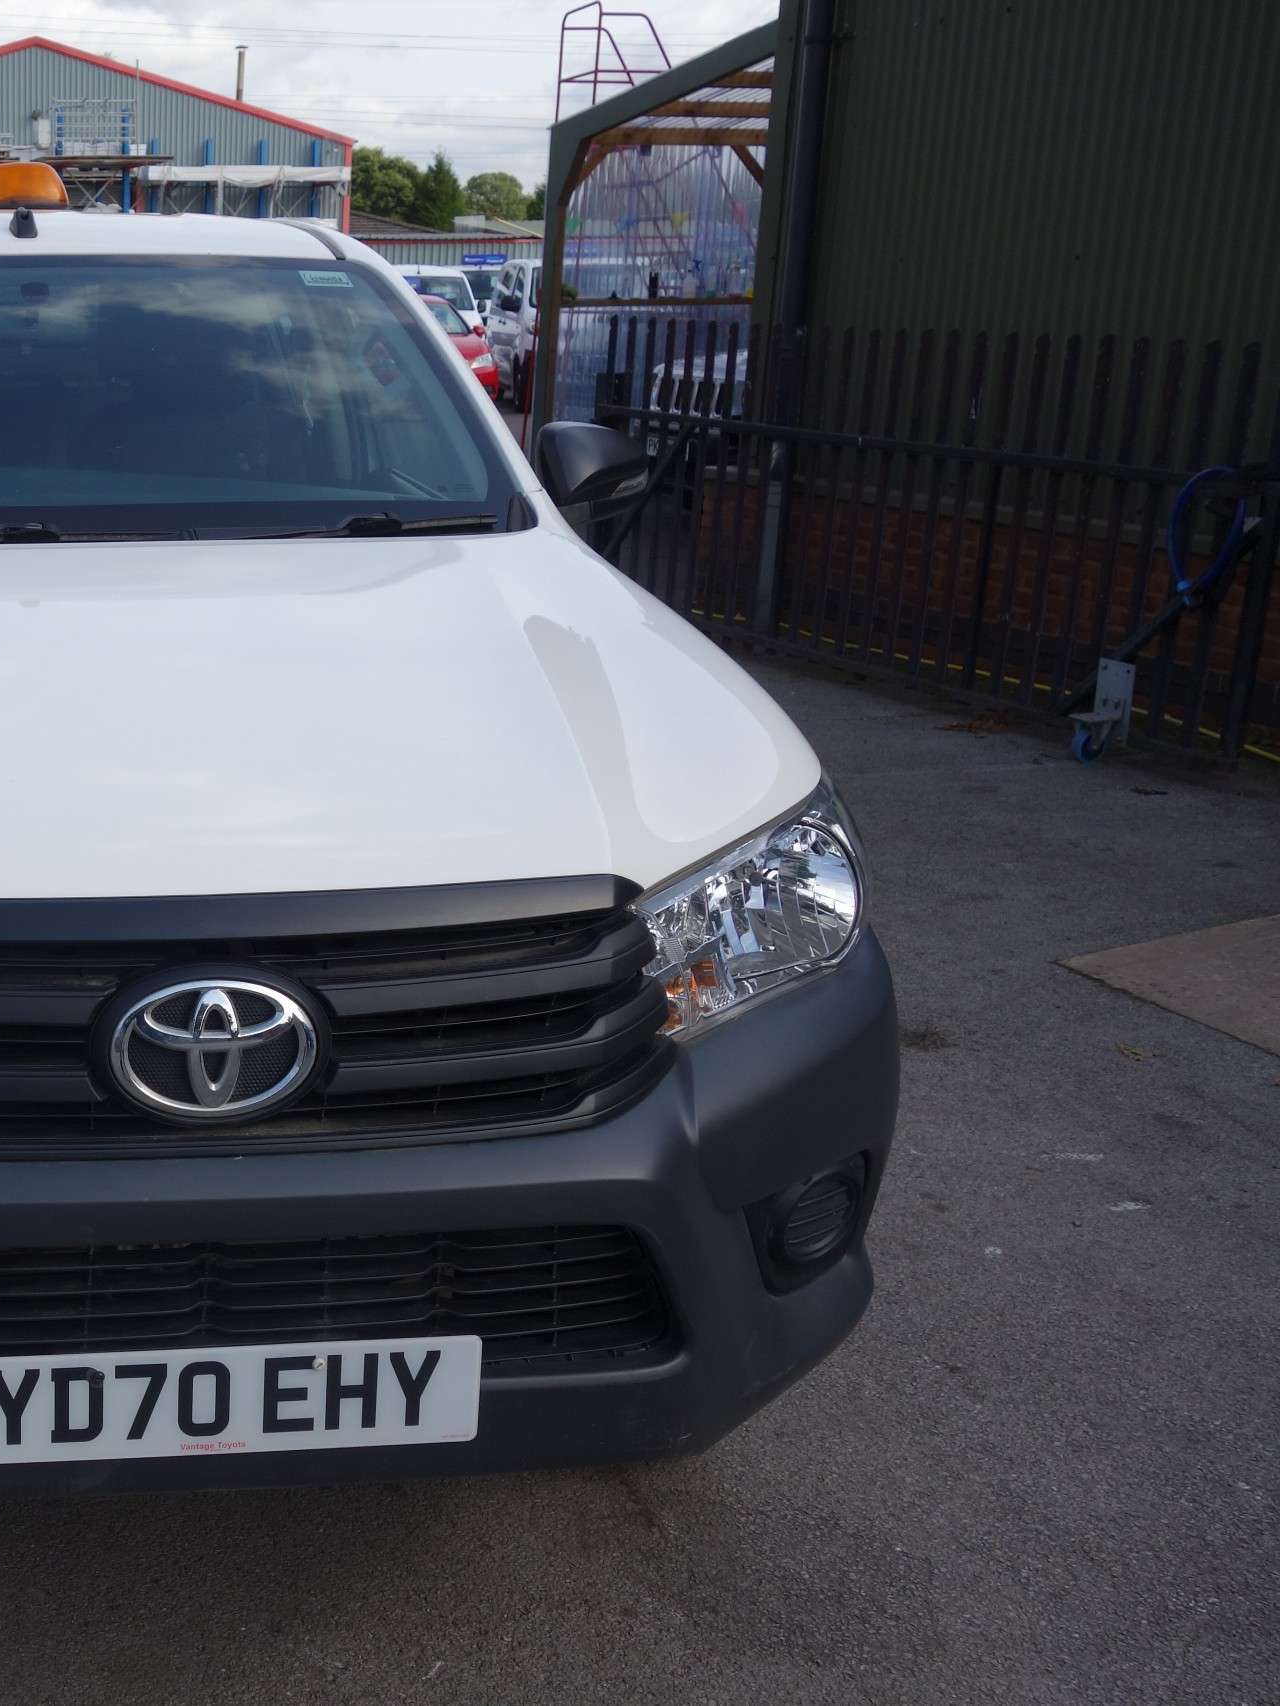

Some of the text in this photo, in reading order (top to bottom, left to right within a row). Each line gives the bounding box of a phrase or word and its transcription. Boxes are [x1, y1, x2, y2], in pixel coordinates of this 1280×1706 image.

[262, 1350, 441, 1434] EHY
[181, 1441, 246, 1451] Vantage Toyota
